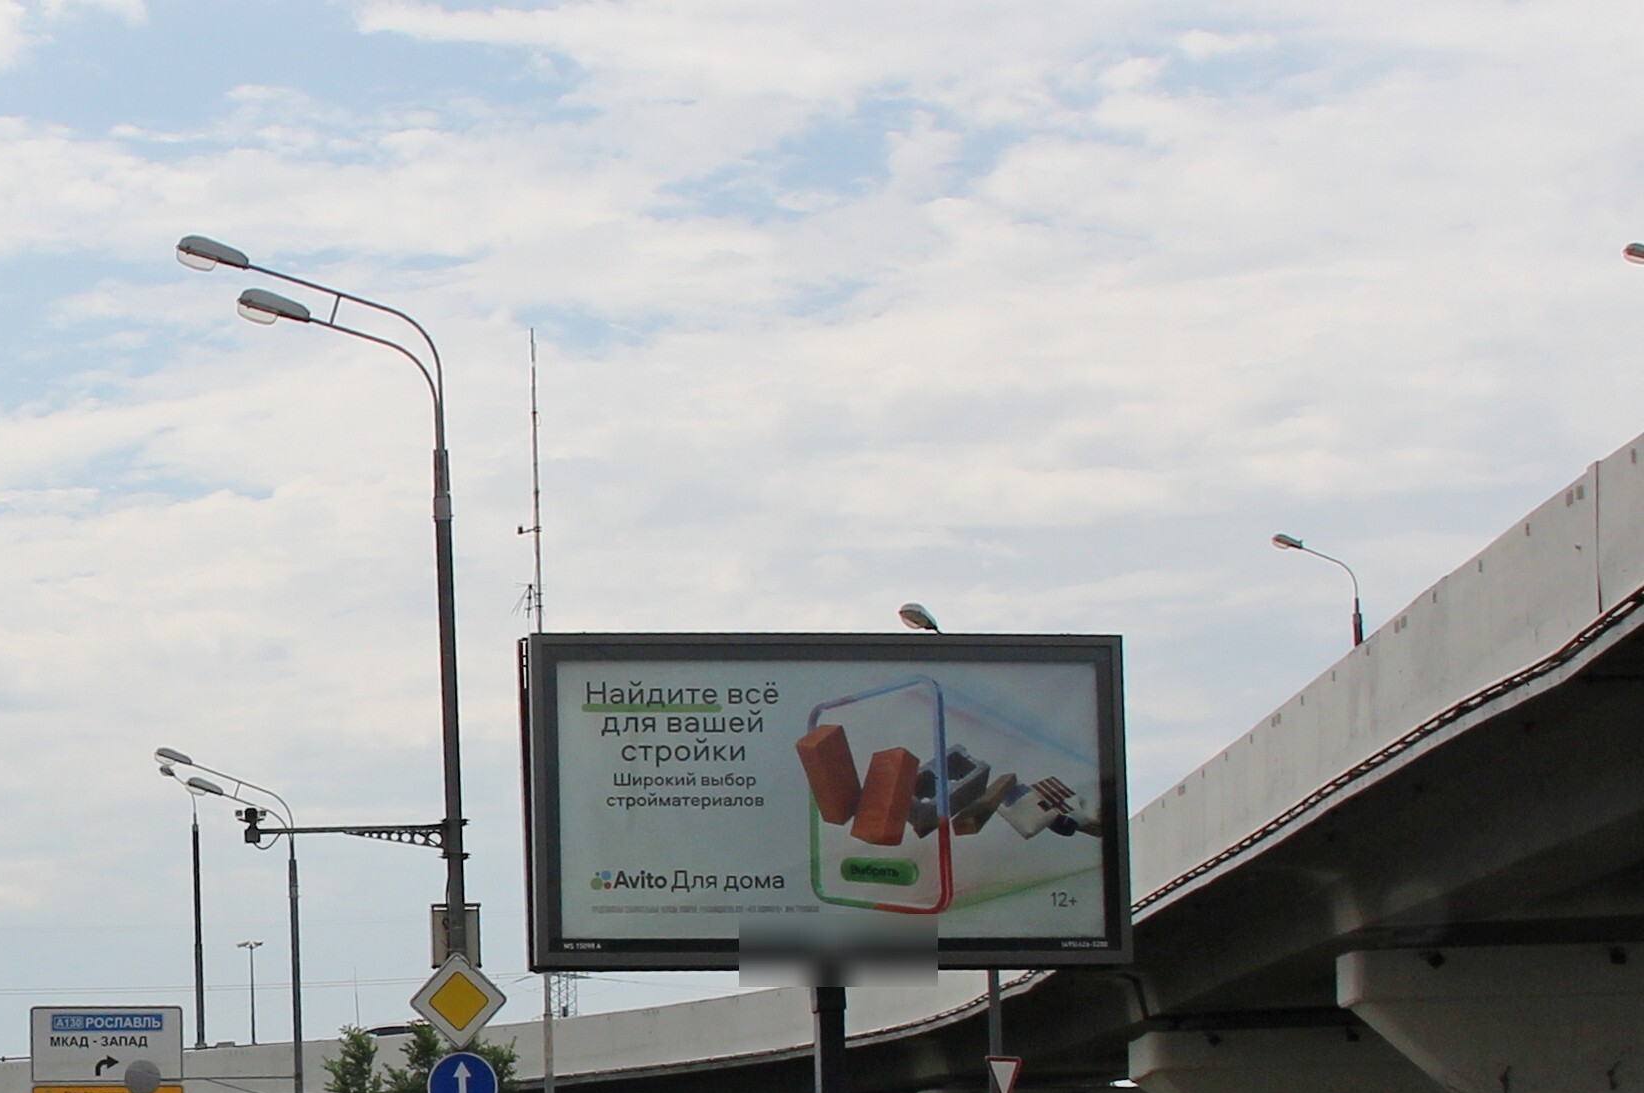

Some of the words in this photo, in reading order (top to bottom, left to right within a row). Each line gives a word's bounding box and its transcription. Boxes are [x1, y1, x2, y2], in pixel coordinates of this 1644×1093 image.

[585, 681, 718, 708] Найдите
[727, 681, 779, 705] всё
[601, 715, 656, 736] для
[667, 709, 764, 733] вашей
[620, 737, 746, 767] стройки
[612, 772, 696, 790] Широкий
[700, 774, 757, 790] выбор
[606, 792, 765, 810] стройматериалов
[612, 869, 668, 890] Avito
[849, 863, 900, 879] Выбрать
[671, 869, 718, 893] Для
[723, 874, 785, 893] дома
[1050, 891, 1078, 908] 12+
[85, 1017, 161, 1028] РОСЛАВЛЬ
[50, 1036, 89, 1048] МКАД
[101, 1036, 148, 1048] ЗАПАД
